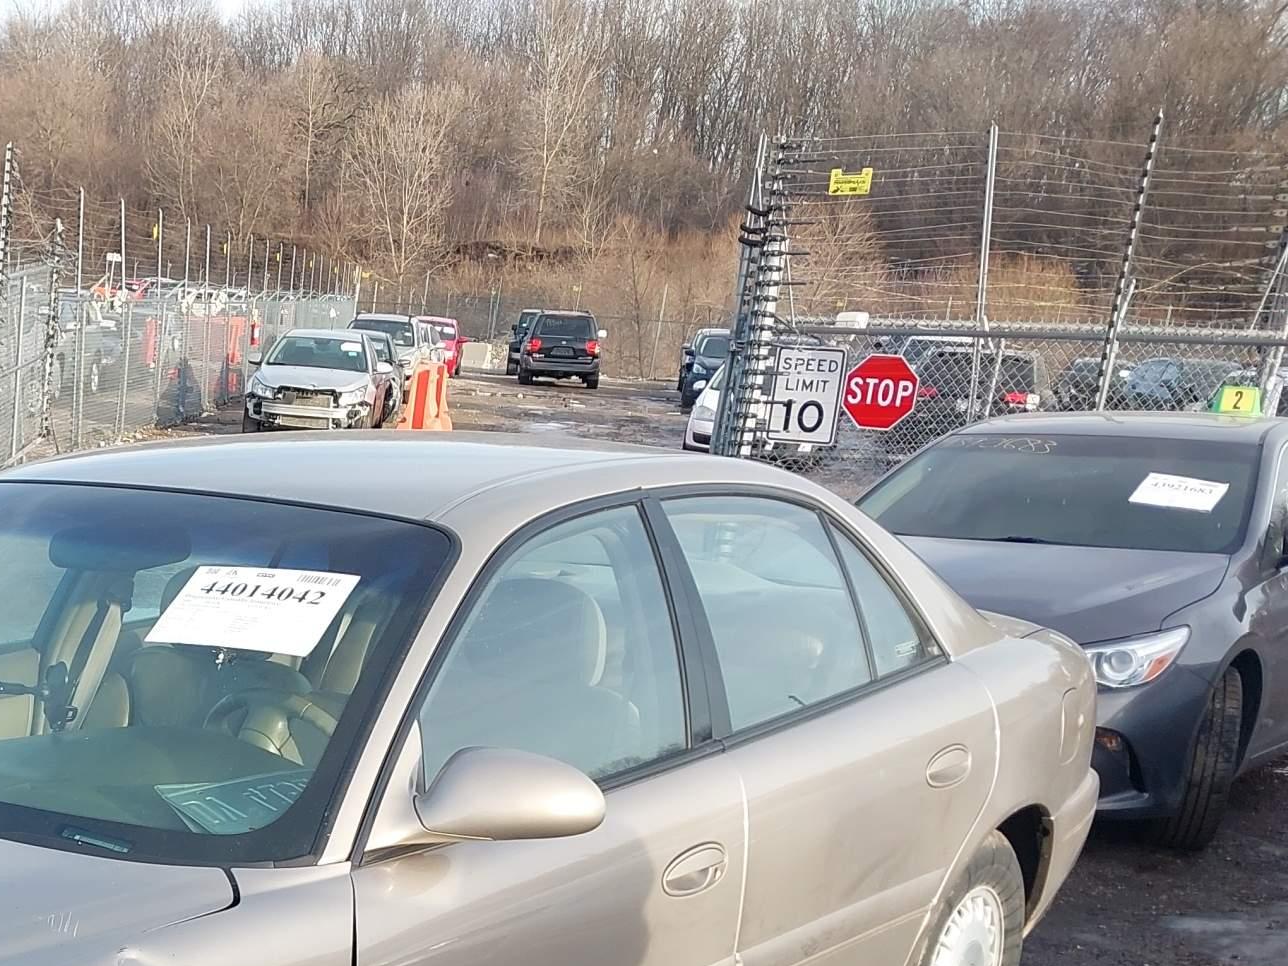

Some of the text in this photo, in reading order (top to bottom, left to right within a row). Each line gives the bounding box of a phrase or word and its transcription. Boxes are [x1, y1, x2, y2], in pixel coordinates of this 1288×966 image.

[782, 357, 839, 373] SPEED
[785, 378, 830, 393] LIMIT
[847, 376, 914, 408] STOP
[1232, 390, 1244, 410] 2
[782, 399, 824, 433] 10
[200, 580, 327, 605] 44014042
